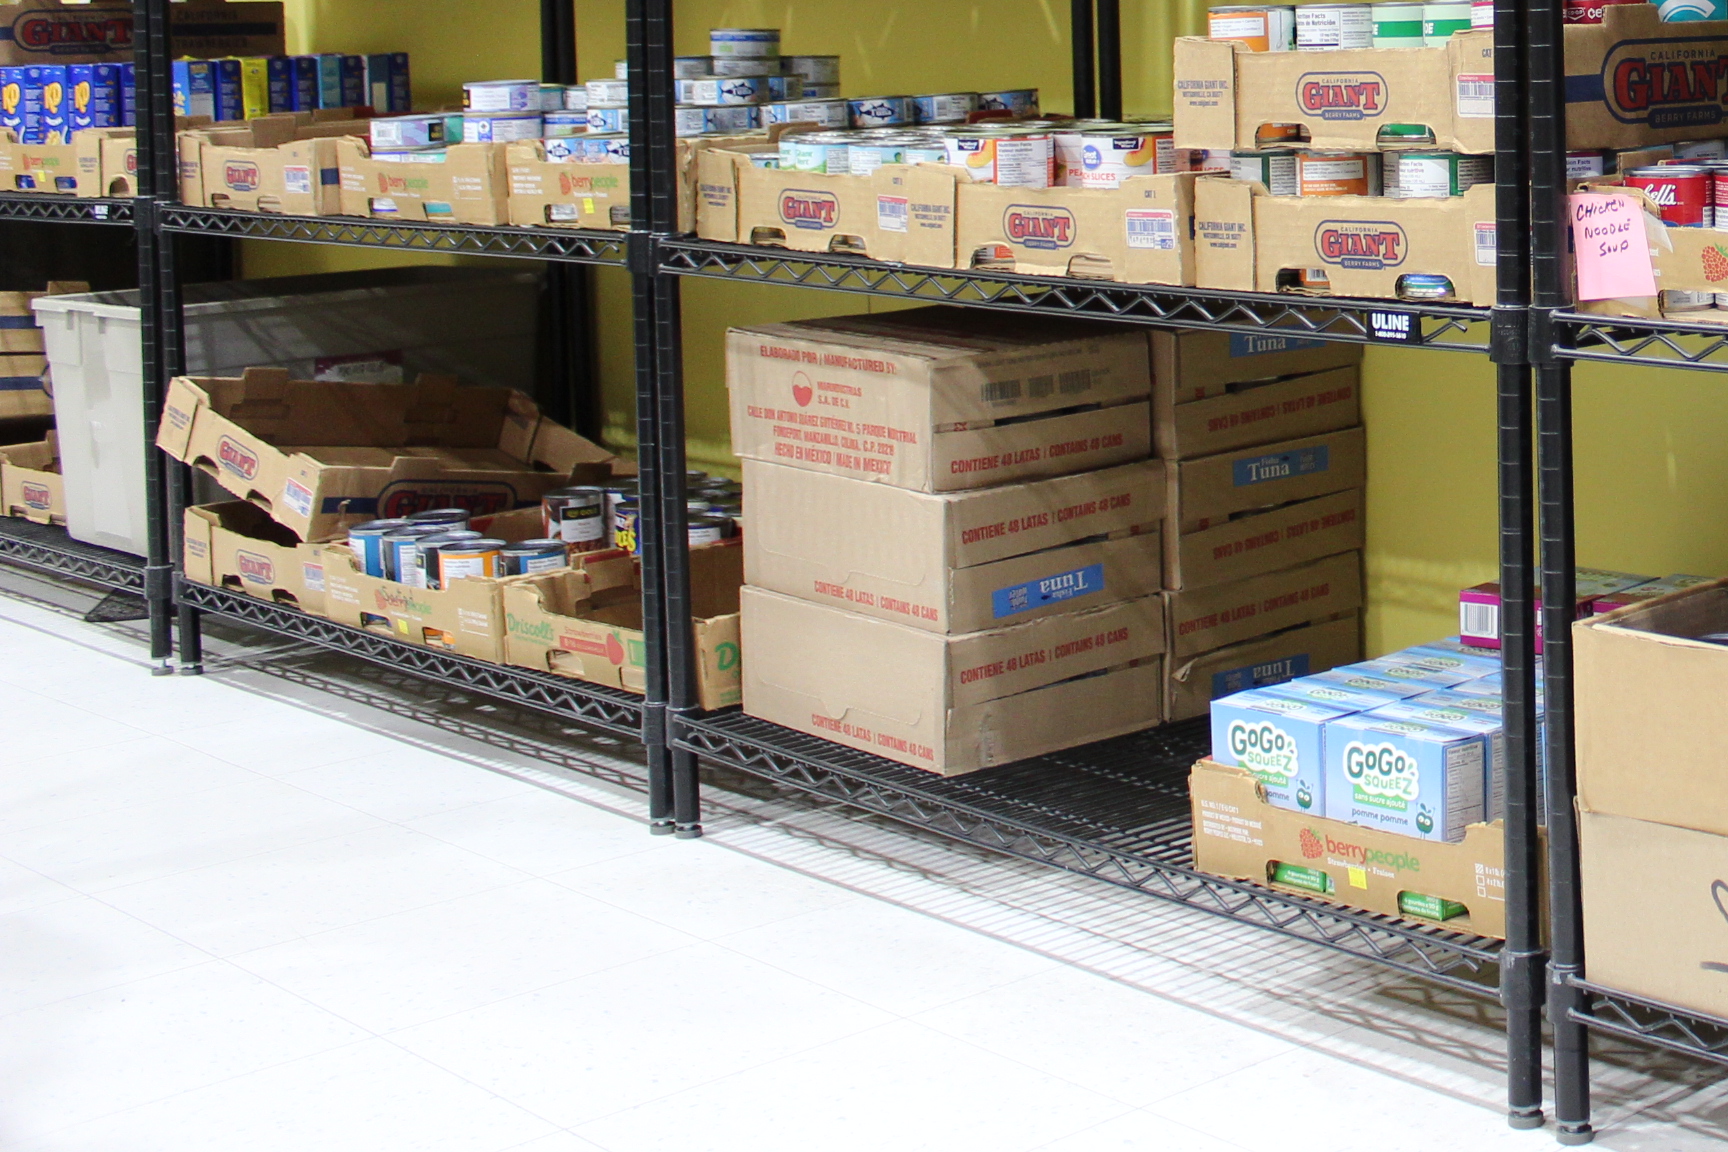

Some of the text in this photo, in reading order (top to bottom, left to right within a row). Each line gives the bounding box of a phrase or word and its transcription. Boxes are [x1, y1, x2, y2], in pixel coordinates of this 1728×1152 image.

[1302, 82, 1380, 110] GIANT
[1090, 171, 1117, 182] SLICES
[783, 196, 835, 223] GIANT
[1008, 213, 1071, 243] GIANT
[1585, 218, 1631, 239] NOODLE
[1321, 229, 1400, 260] GIANT
[1371, 312, 1410, 332] ULINE
[1244, 334, 1287, 354] Tuna
[760, 345, 885, 374] ELABORADO POR MANUFACTURED
[864, 454, 892, 475] MEXICO
[951, 432, 1123, 475] CONTIENE LATAS CONTAINS CANS
[1247, 461, 1290, 482] Tuna
[962, 493, 1131, 546] CONTIENE LATAS CONTAINS CANS
[1039, 569, 1089, 595] Tuna
[814, 580, 938, 622] CONTIENE LATAS CONTAINS CANS
[507, 611, 555, 641] Driscoll's
[960, 627, 1129, 685] CONTIENE LATAS CONTAINS CANS
[1231, 725, 1285, 757] GoGo
[1247, 750, 1294, 772] SQUEEZ
[1346, 747, 1406, 779] GoGo
[1364, 773, 1414, 796] SQUEEZ
[1352, 807, 1409, 826] pomme pomme
[1325, 835, 1420, 873] berrypeople
